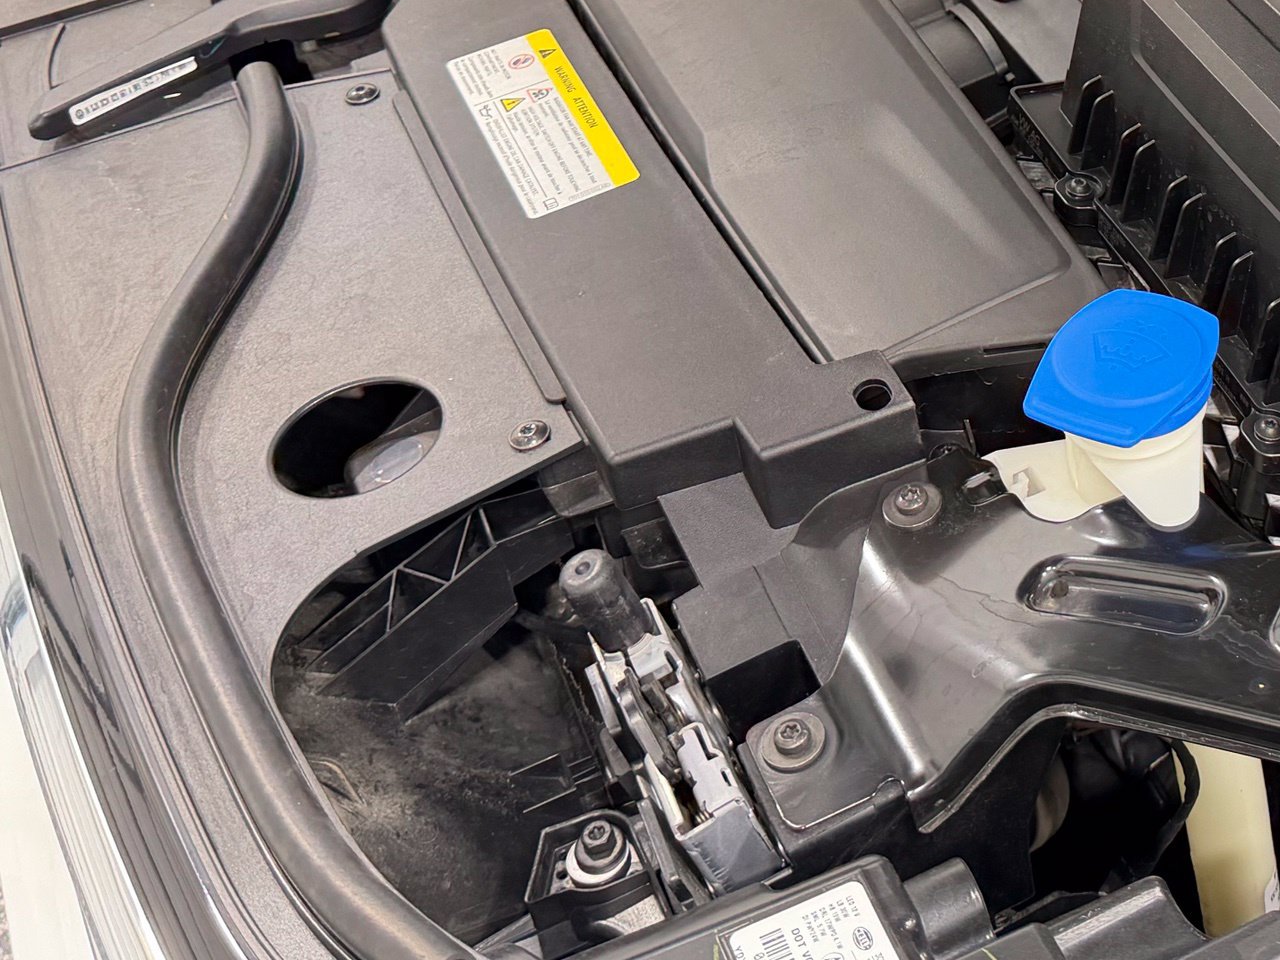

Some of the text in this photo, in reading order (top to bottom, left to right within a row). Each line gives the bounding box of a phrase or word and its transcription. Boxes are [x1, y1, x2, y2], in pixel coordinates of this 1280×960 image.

[554, 65, 576, 93] WARNING
[572, 97, 598, 129] ATTENTION
[791, 928, 807, 948] DOT
